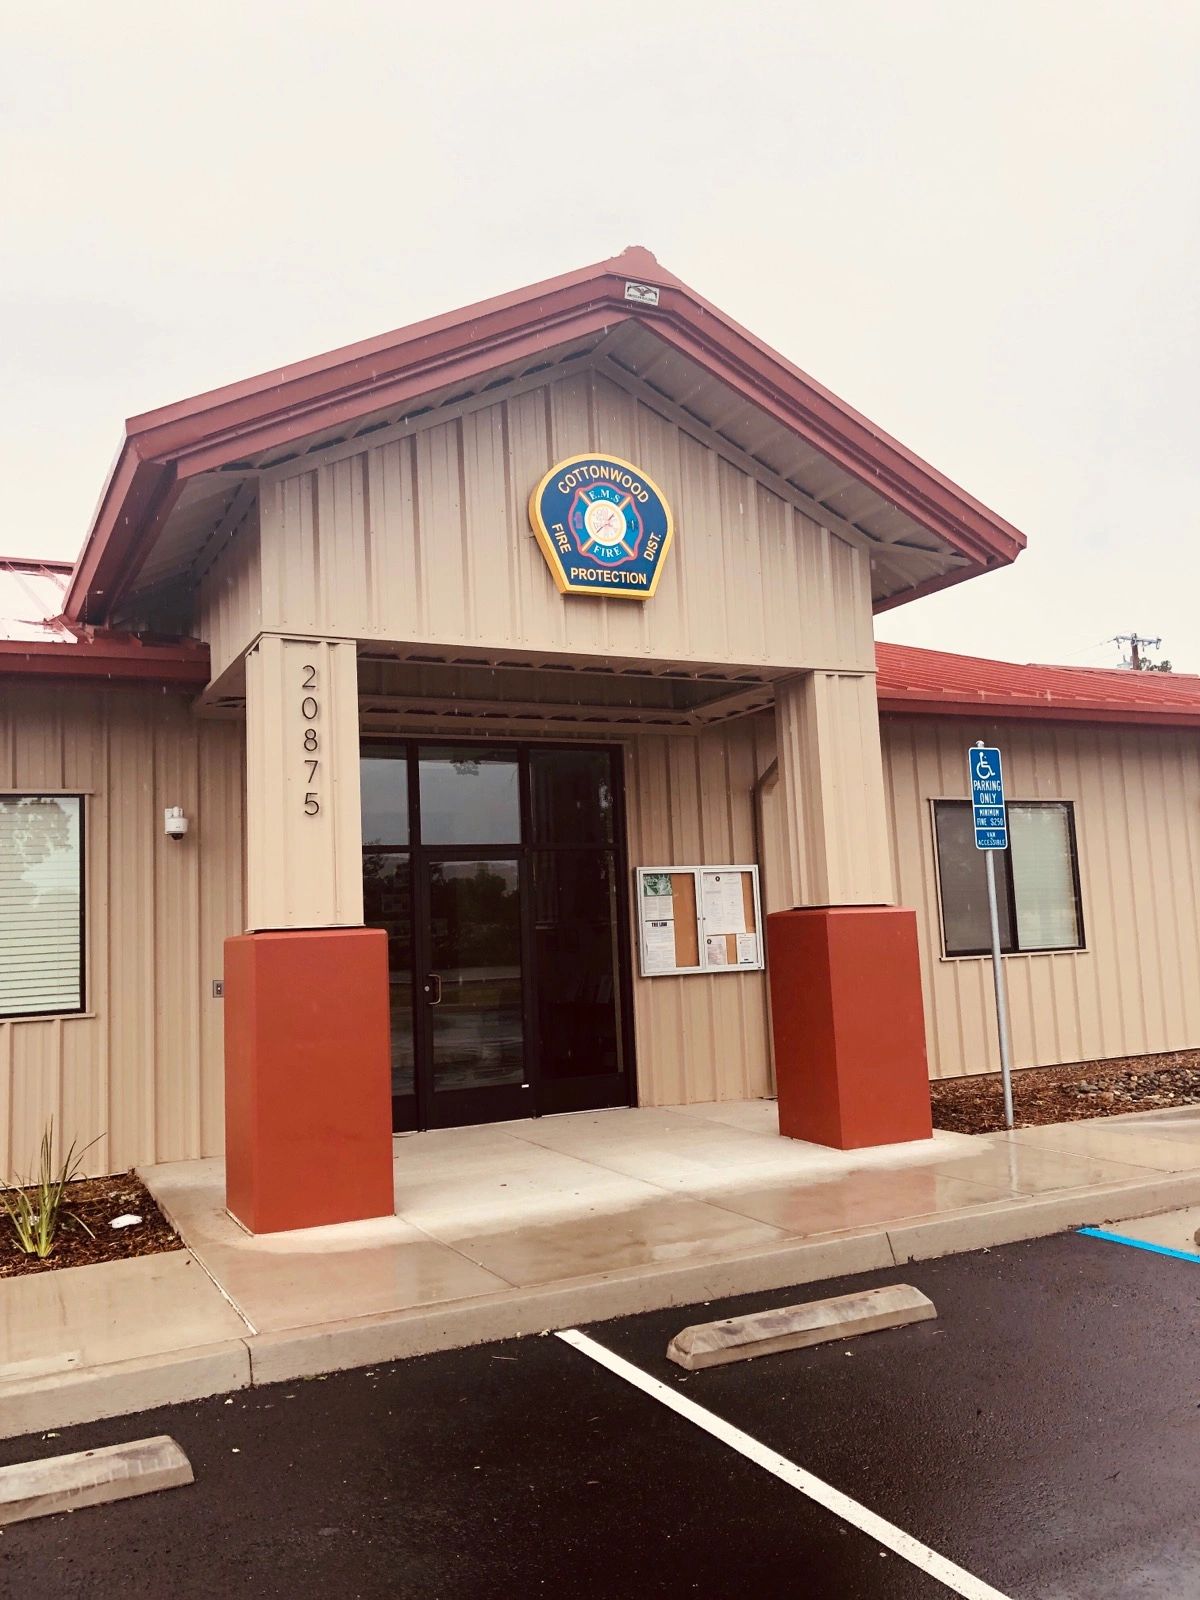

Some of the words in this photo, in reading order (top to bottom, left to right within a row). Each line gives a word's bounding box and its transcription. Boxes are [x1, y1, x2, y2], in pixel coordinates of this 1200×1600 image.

[558, 465, 649, 503] COTTONWOOD
[552, 523, 572, 554] FIRE
[593, 545, 622, 558] FIRE
[643, 532, 662, 561] DIST.
[570, 567, 647, 585] PROTECTION
[302, 665, 320, 816] 20875
[973, 780, 1001, 792] PARKING
[980, 792, 997, 804] ONLY
[979, 808, 1000, 817] MINIMUM
[977, 818, 987, 826] FINE
[990, 817, 1004, 826] $250
[978, 838, 1005, 846] ACCESSIBLE
